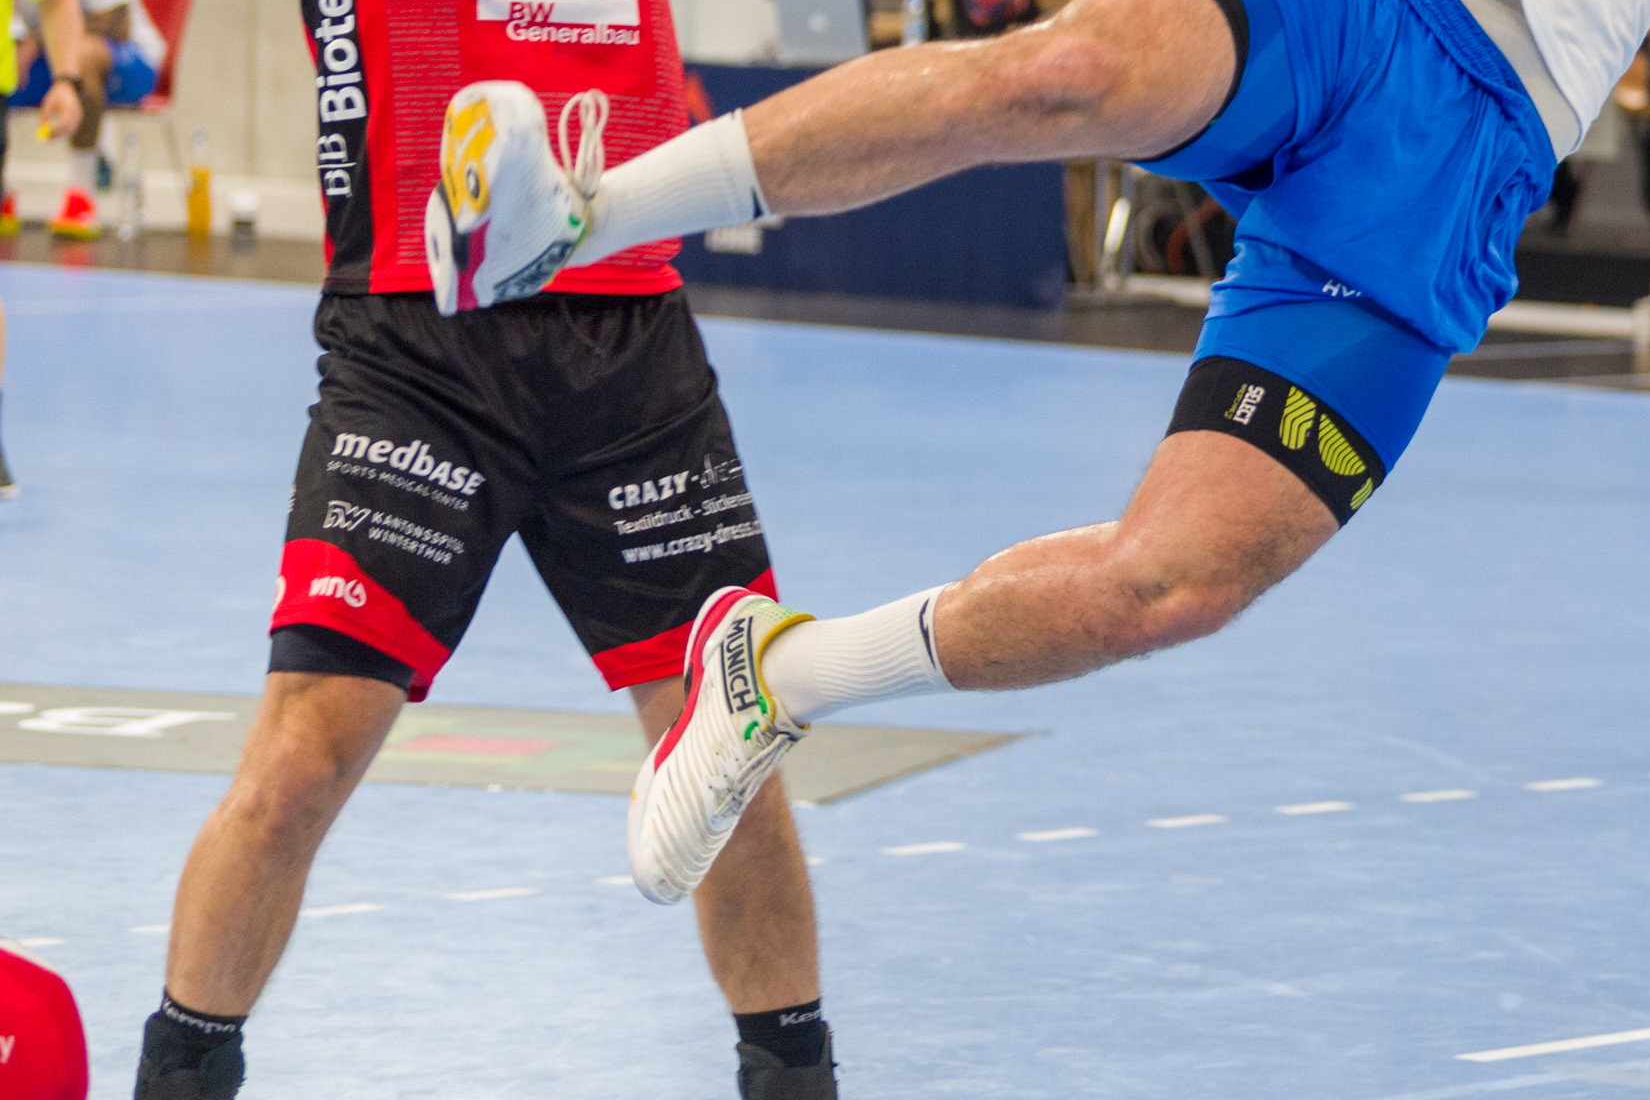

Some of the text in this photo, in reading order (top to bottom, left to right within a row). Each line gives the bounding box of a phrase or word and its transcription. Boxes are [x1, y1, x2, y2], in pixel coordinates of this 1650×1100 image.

[507, 1, 556, 26] BW
[505, 18, 642, 46] Generalbau
[1232, 384, 1266, 426] SELECT
[726, 617, 759, 713] MUNICH
